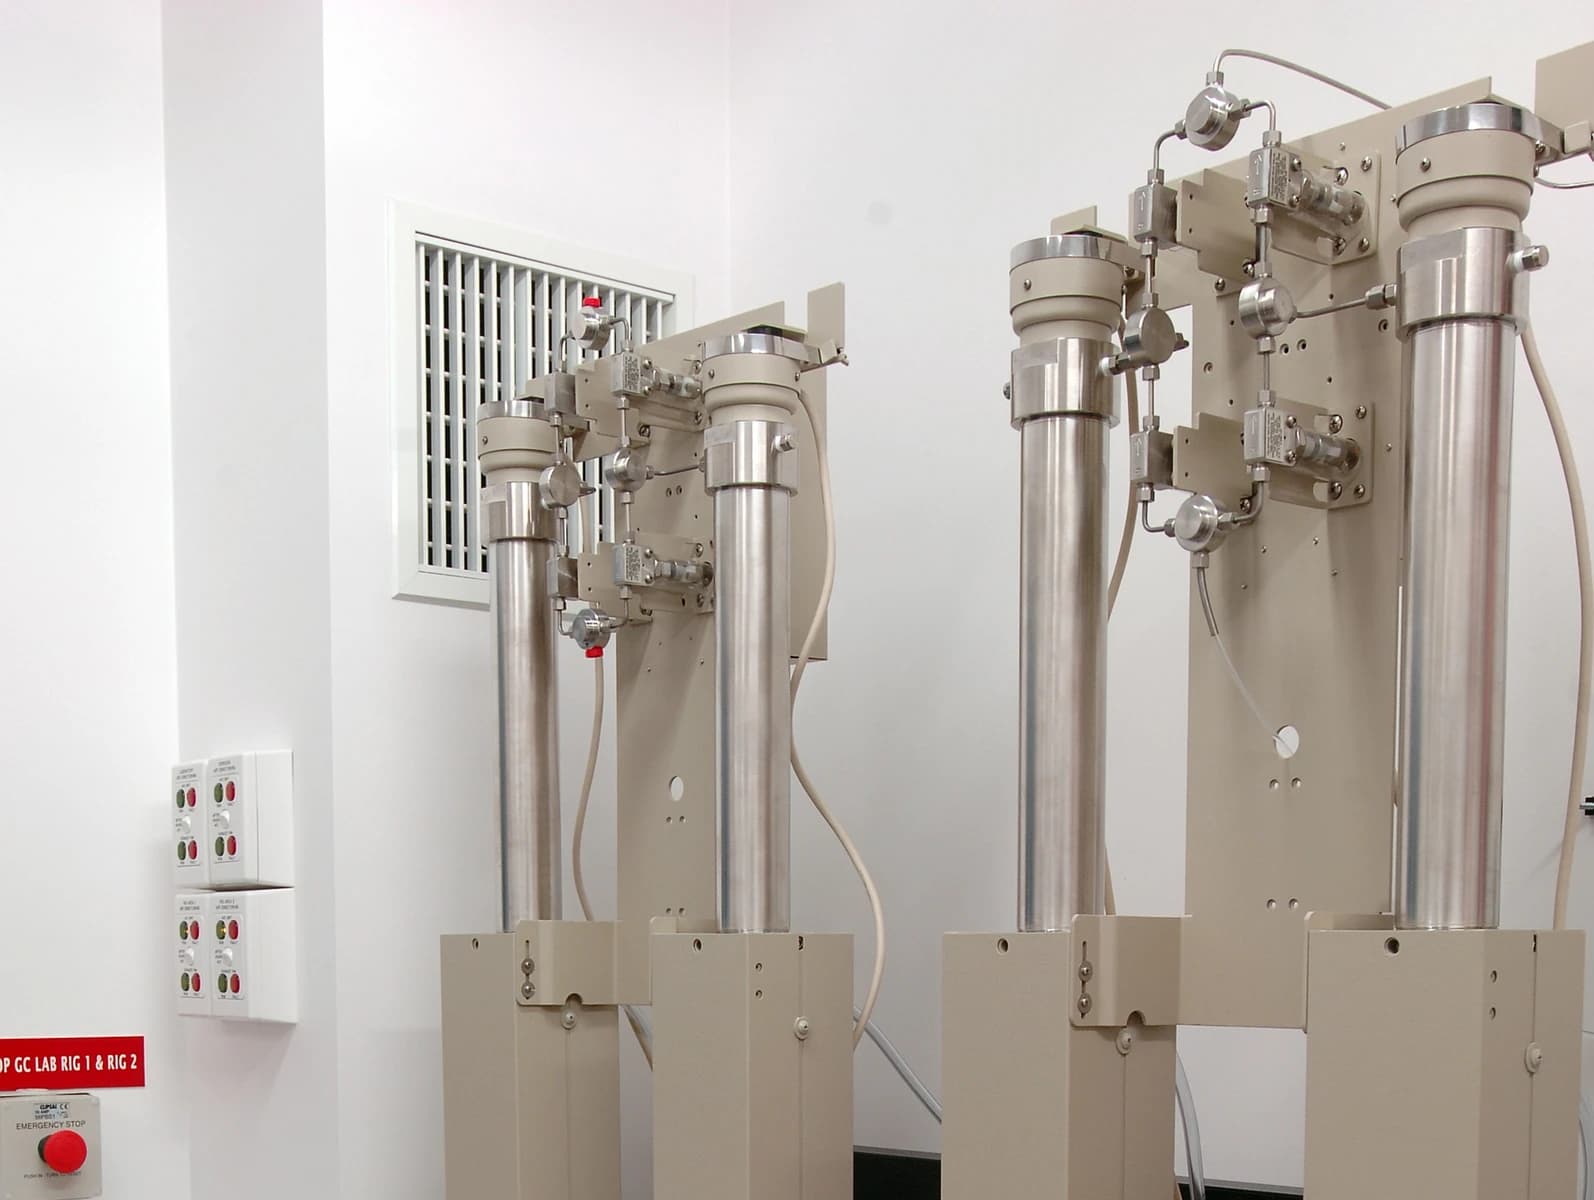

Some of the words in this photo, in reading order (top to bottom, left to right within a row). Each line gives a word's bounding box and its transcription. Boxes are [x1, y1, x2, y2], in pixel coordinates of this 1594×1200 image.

[14, 1057, 31, 1073] GC
[35, 1056, 57, 1072] LAB
[61, 1055, 81, 1071] RIG
[85, 1055, 90, 1071] 1
[95, 1055, 104, 1071] &
[107, 1054, 126, 1070] RIG
[130, 1054, 137, 1069] 2
[16, 1121, 64, 1130] EMERGENCY
[66, 1120, 86, 1128] STOP
